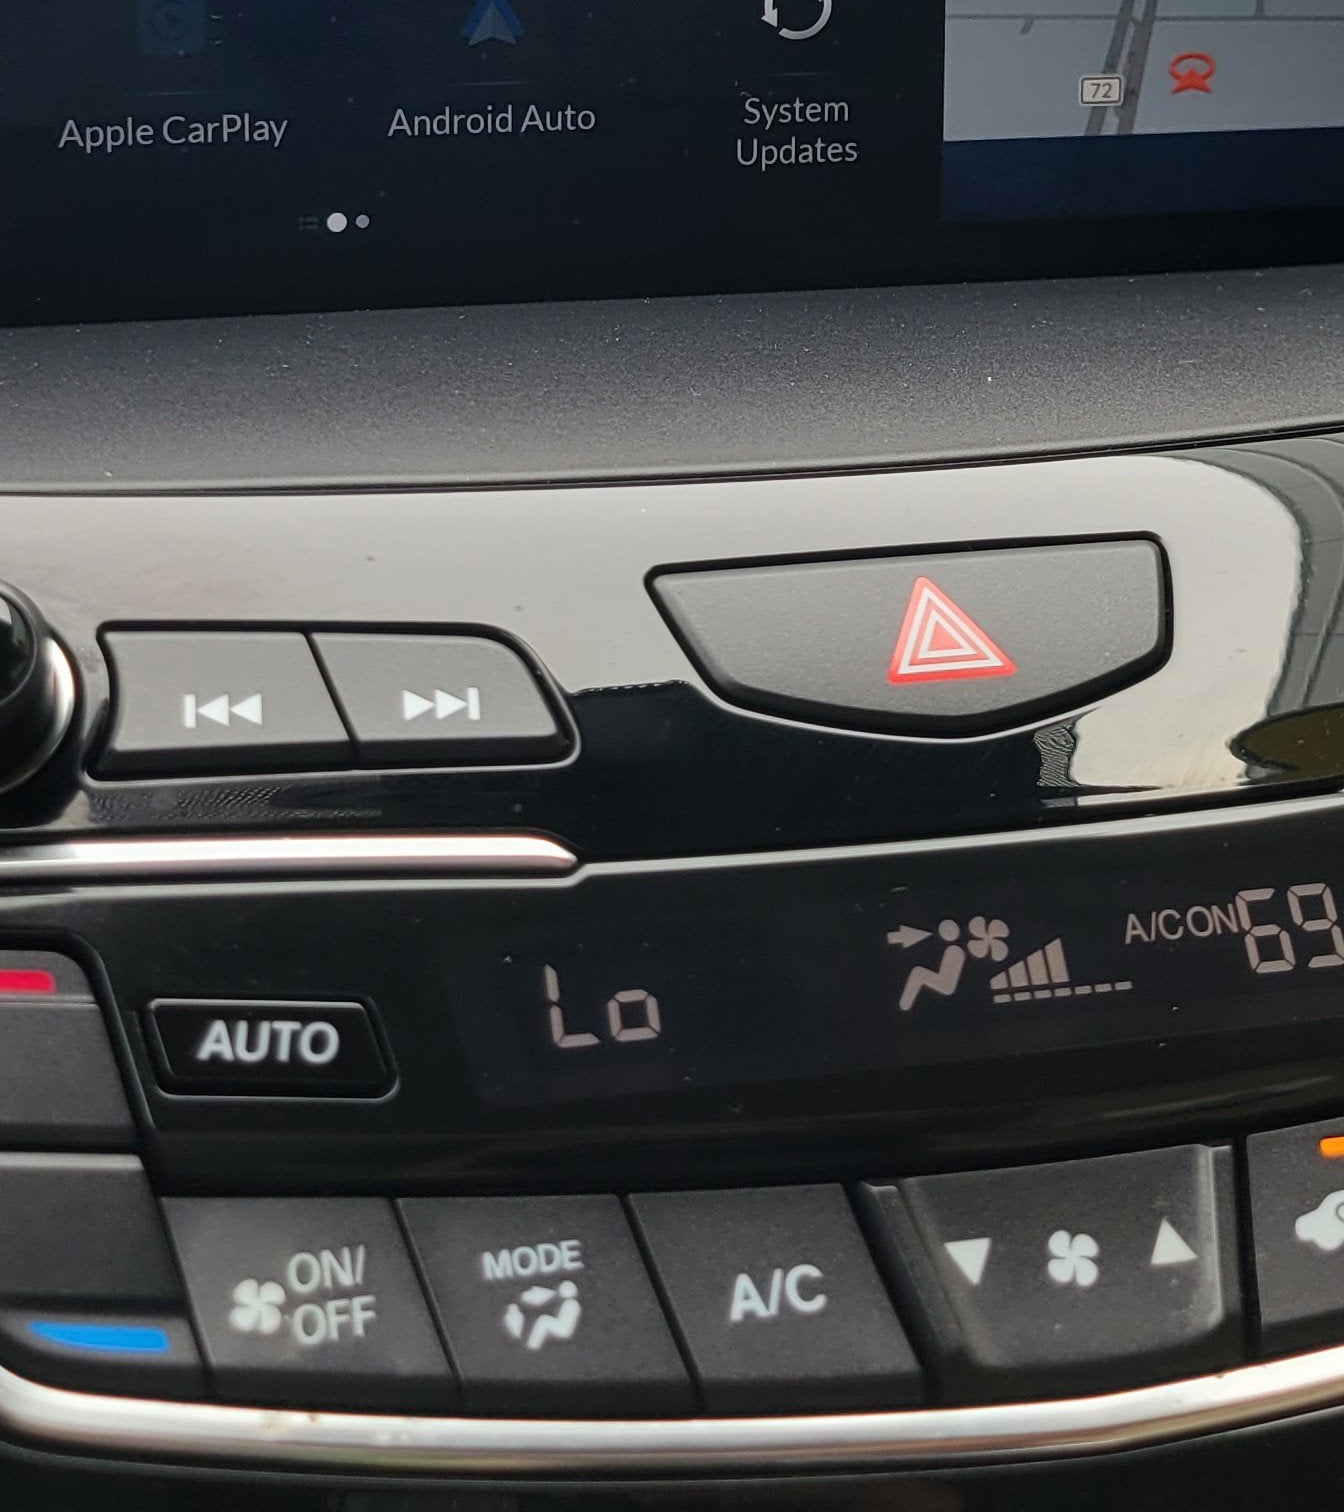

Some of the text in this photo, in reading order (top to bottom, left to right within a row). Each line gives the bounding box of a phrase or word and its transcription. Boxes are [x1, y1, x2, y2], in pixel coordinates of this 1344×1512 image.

[1089, 82, 1113, 99] 72
[58, 112, 289, 153] Apple CarPlay
[388, 102, 596, 137] Android Auto
[744, 96, 850, 129] System
[736, 138, 858, 171] Updates
[197, 1019, 339, 1065] AUTO
[482, 1240, 584, 1281] MODE
[729, 1263, 826, 1322] A/C
[292, 1295, 376, 1346] OFF
